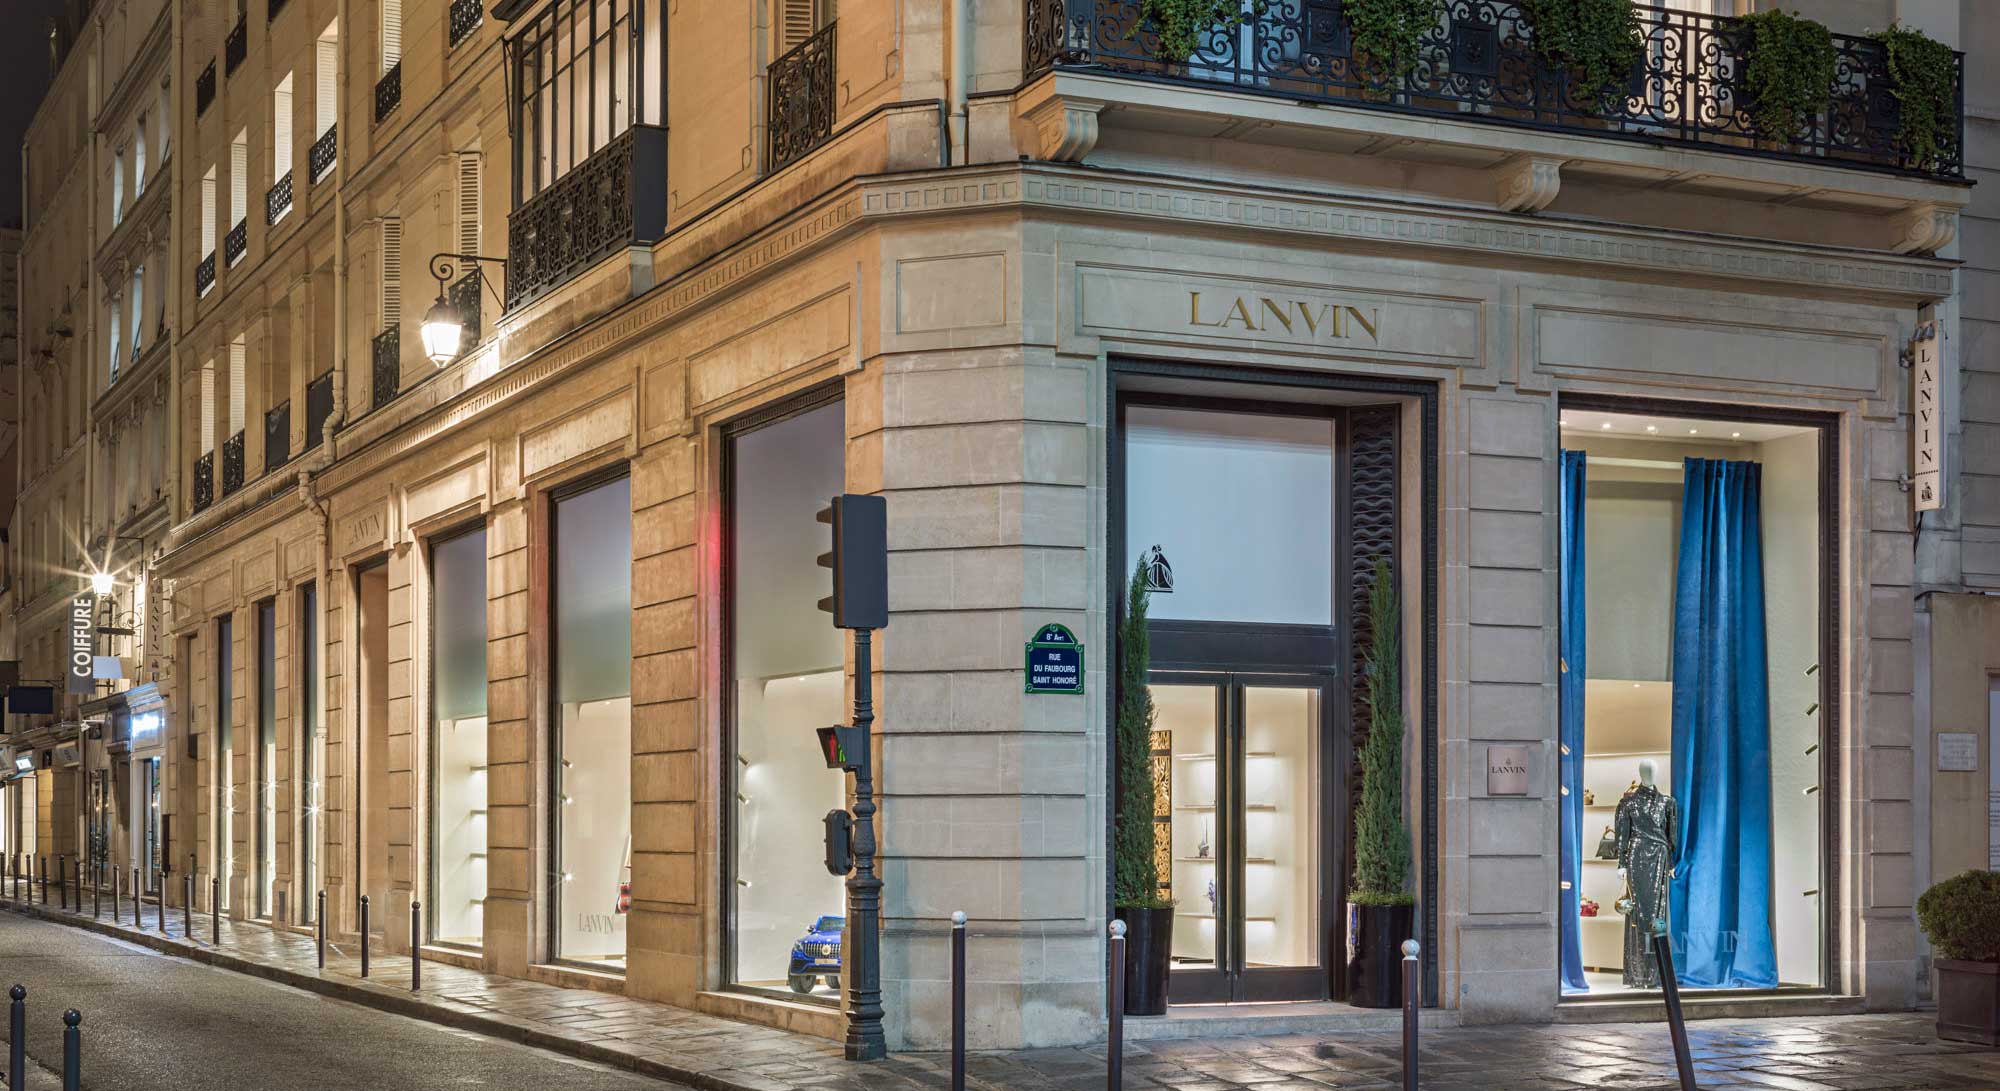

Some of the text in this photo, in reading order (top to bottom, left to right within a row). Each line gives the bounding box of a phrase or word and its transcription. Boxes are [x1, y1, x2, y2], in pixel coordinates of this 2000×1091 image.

[1189, 291, 1378, 345] LANVIN
[1920, 349, 1933, 465] LANVIN
[73, 599, 92, 677] COIFFURE
[1048, 653, 1061, 661] RUE
[1033, 664, 1076, 673] DU FAUBOURG
[1032, 675, 1077, 685] SAINT HONORÉ
[1491, 766, 1526, 774] LANVIN
[577, 911, 615, 935] LANVIN
